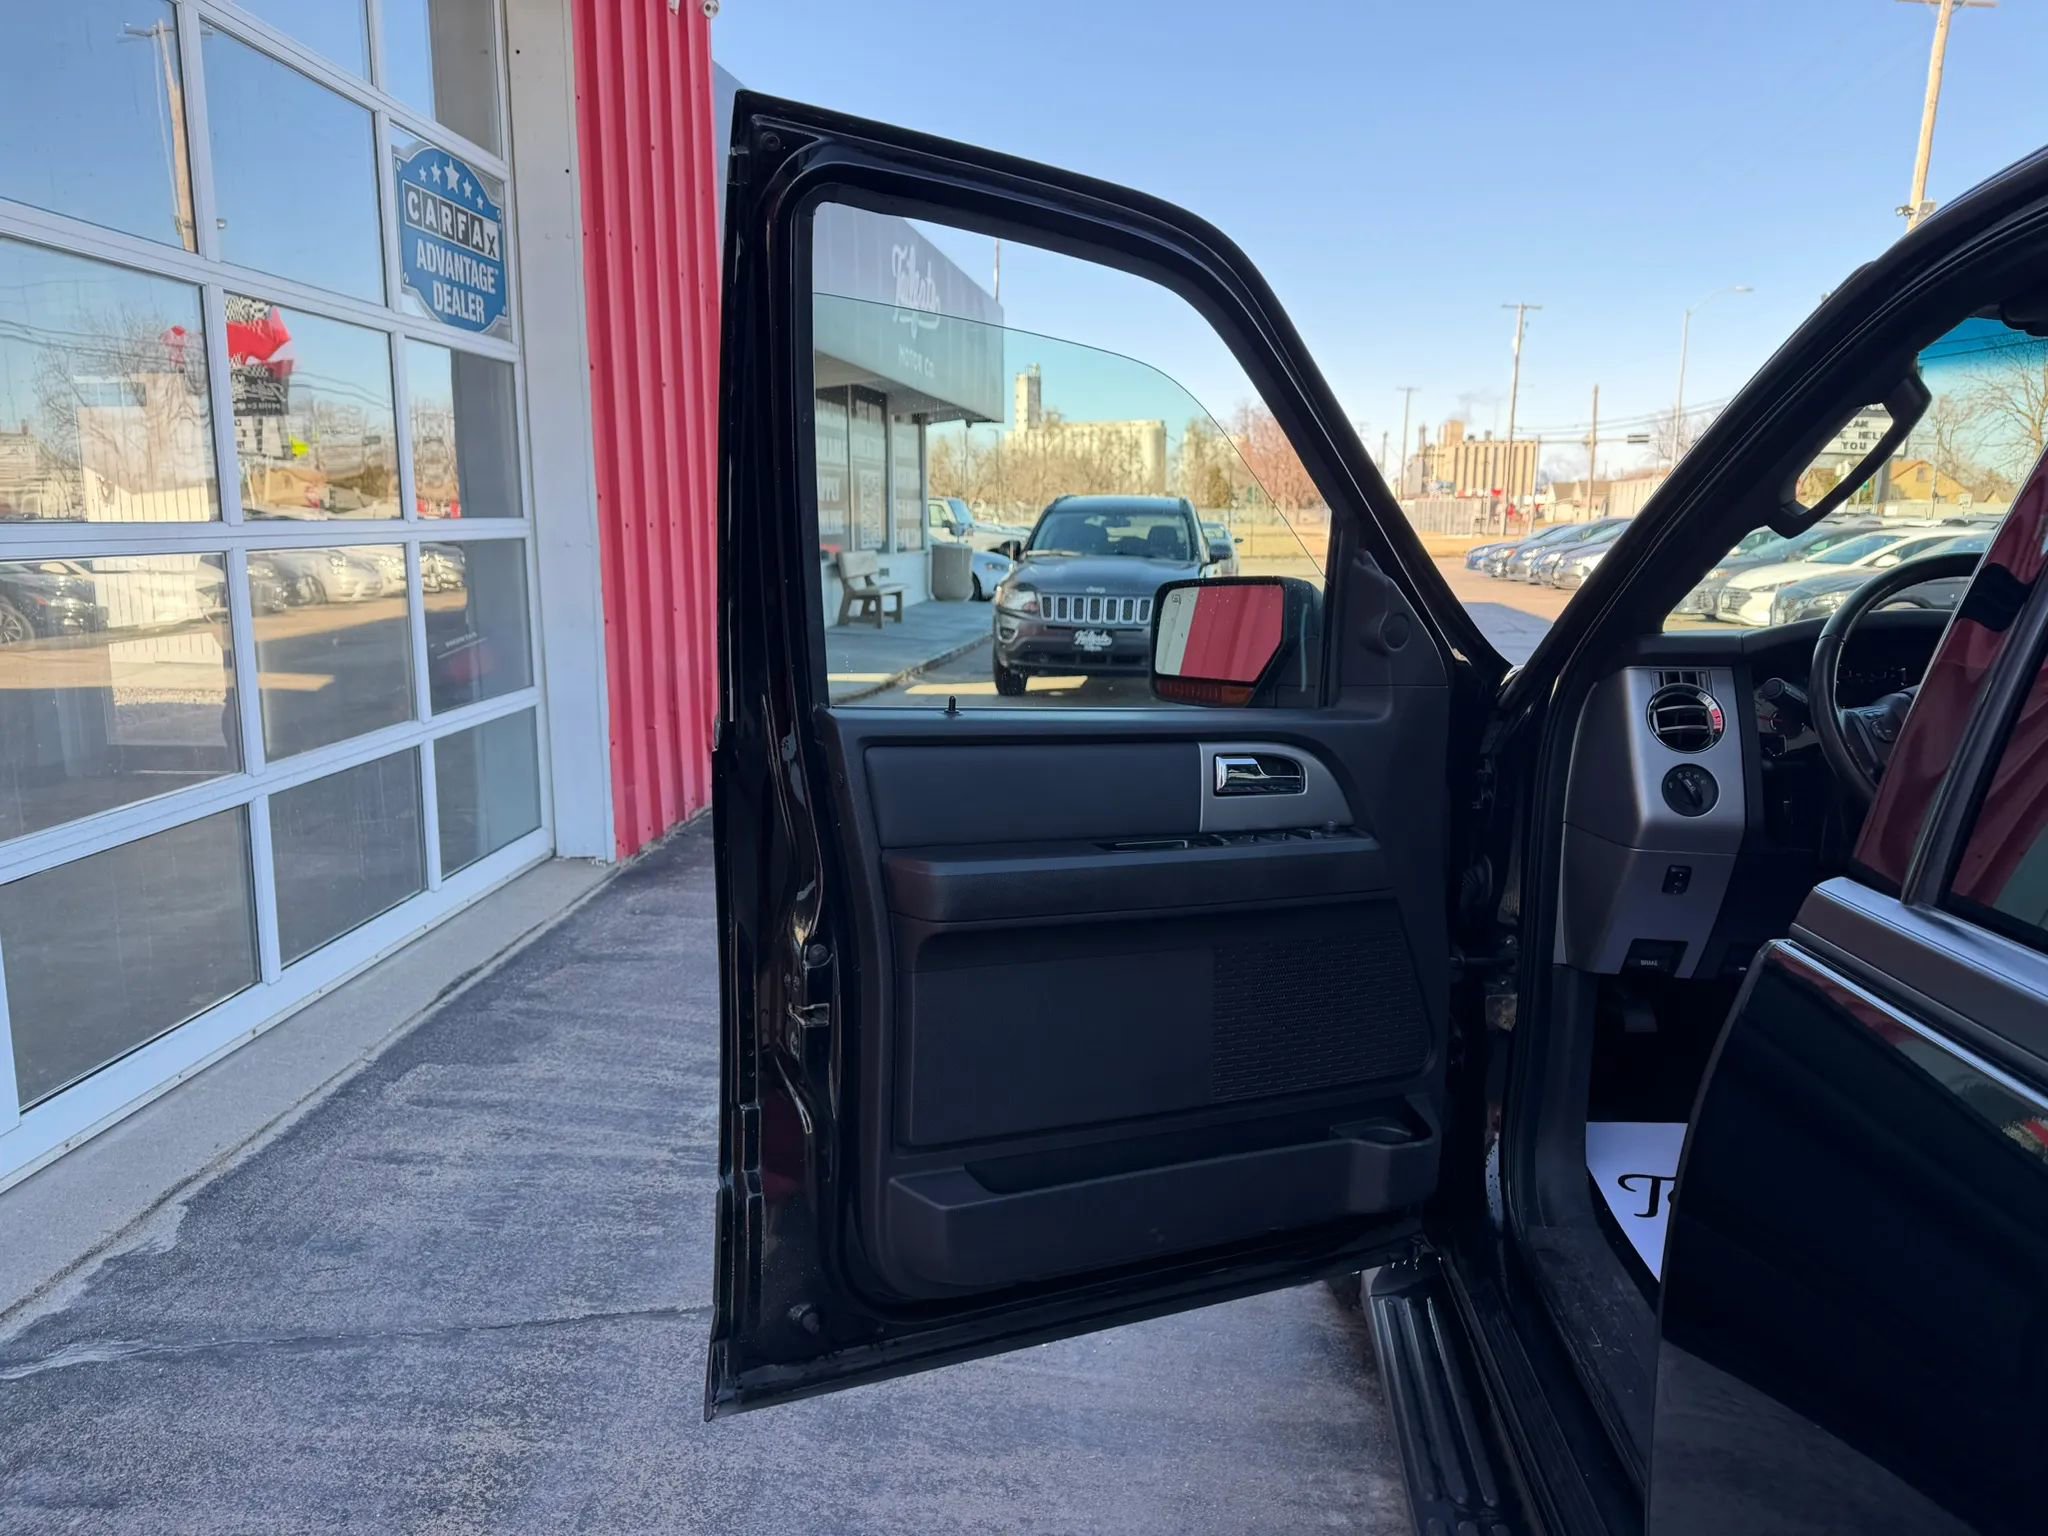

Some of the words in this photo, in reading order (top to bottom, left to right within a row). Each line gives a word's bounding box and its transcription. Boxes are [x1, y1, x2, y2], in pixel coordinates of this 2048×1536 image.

[407, 191, 497, 258] CARFAX
[416, 238, 496, 294] ADVANTAGE
[432, 280, 485, 324] DEALER
[1841, 441, 1867, 450] YOU
